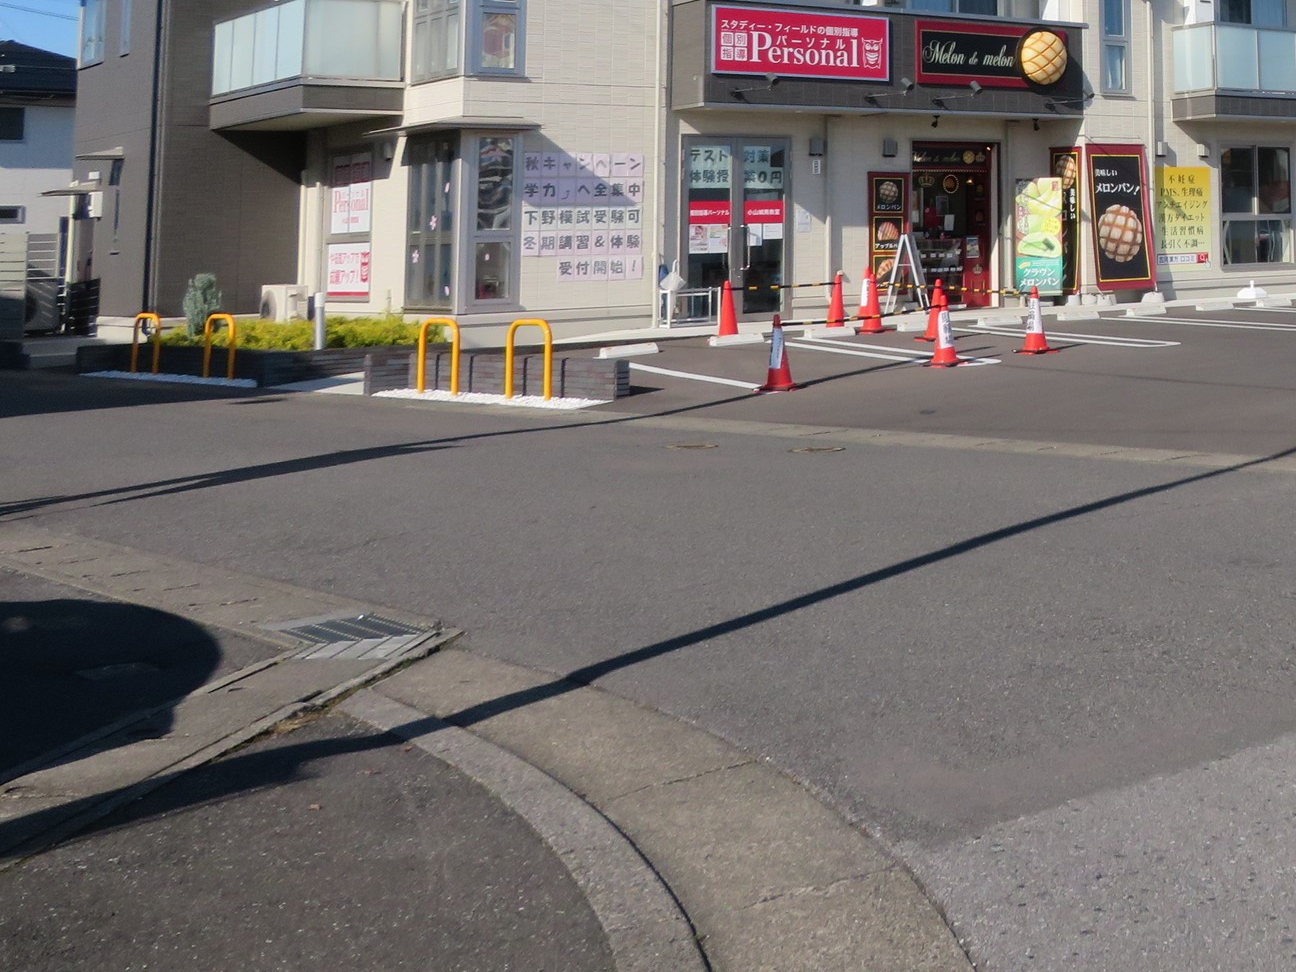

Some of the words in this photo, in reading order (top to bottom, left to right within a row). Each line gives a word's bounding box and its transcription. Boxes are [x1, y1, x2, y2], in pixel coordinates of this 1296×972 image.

[720, 20, 859, 38] スタディー・フィールドの個別指導
[749, 30, 860, 68] Personal
[775, 36, 846, 50] パーソナル
[922, 39, 966, 65] Melon
[968, 51, 979, 65] de
[982, 44, 1016, 67] melon
[690, 149, 728, 162] テスト
[689, 169, 729, 183] 体験授
[1095, 168, 1118, 177] 美味しい
[1168, 174, 1196, 184] 不妊症
[1157, 200, 1208, 209] アンチエイジング
[524, 209, 641, 226] 下野模試受験可
[1158, 212, 1205, 223] 漢方ダイエット
[1161, 225, 1204, 236] 生活習慣病
[1023, 267, 1055, 277] クラウン
[1019, 277, 1060, 287] メロンパン
